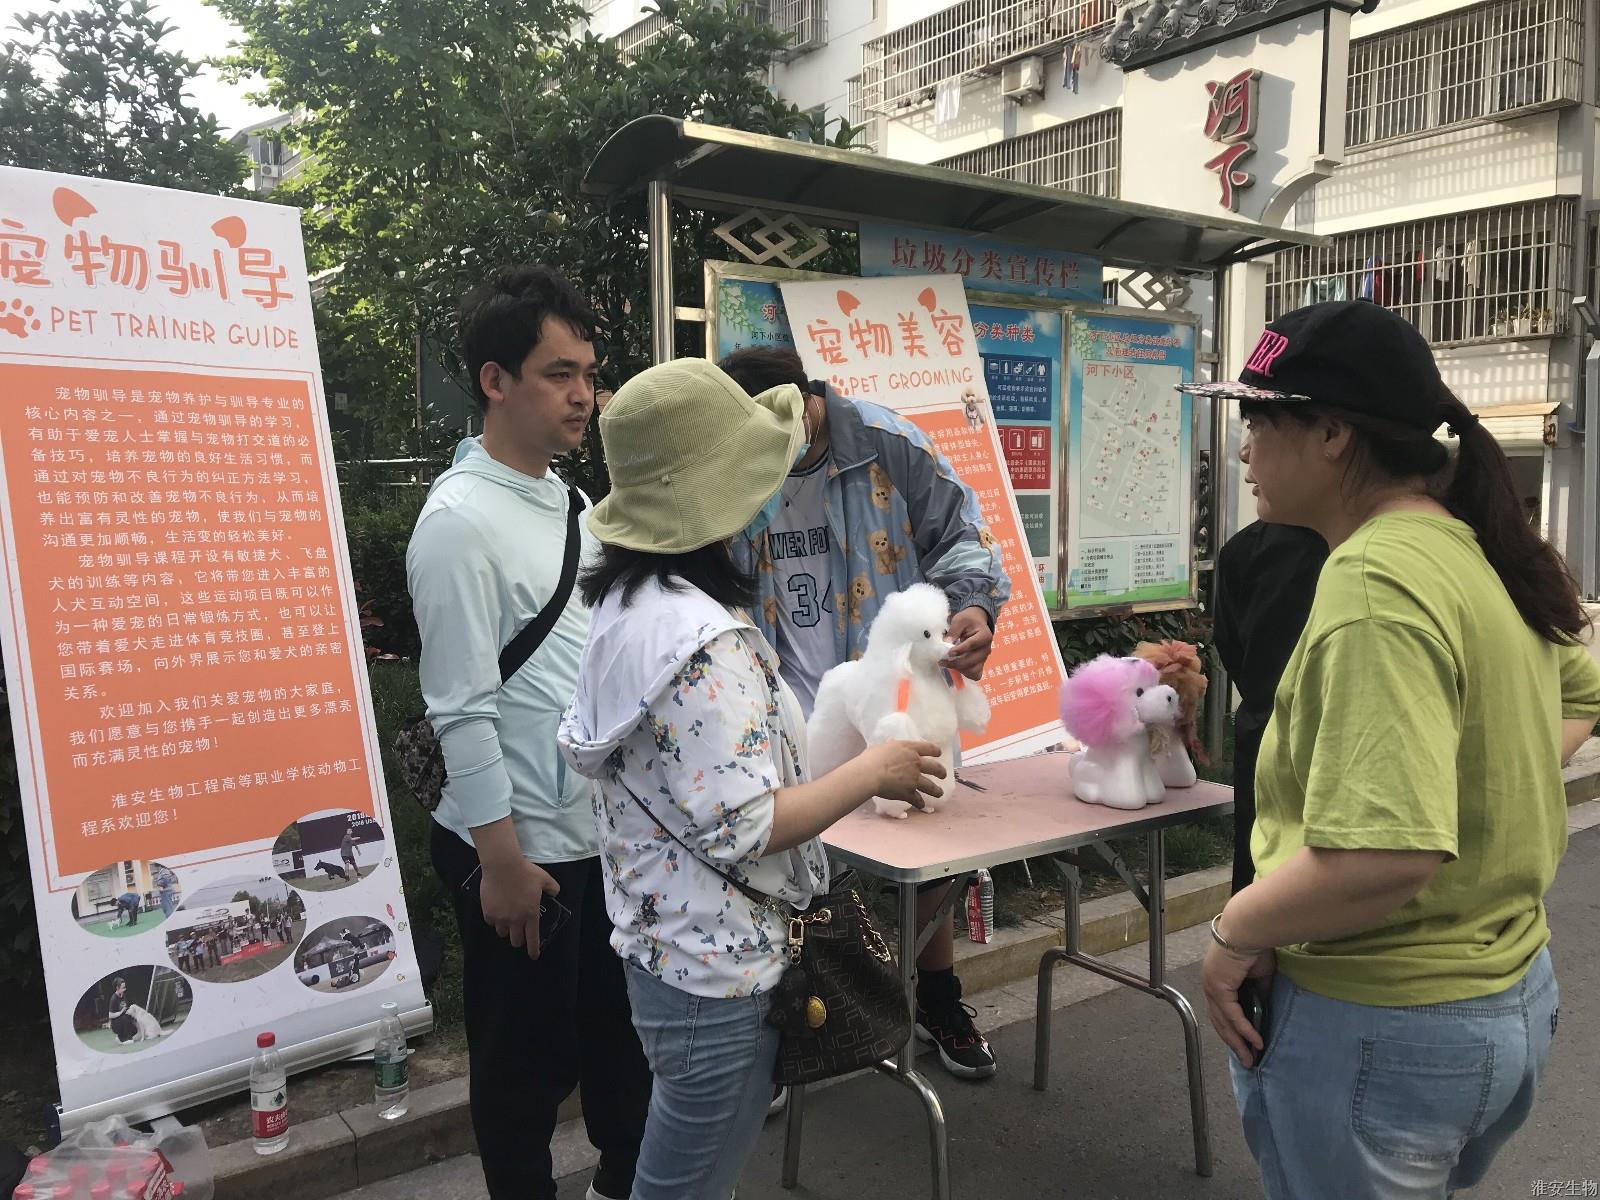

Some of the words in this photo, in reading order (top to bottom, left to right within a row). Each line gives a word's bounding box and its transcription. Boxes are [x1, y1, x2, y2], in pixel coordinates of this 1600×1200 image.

[1203, 67, 1258, 211] 河下
[0, 218, 295, 310] 宠物驯导
[891, 236, 1080, 289] 垃圾分类宣传栏
[50, 306, 98, 335] PET
[111, 312, 216, 345] TRAINER
[228, 324, 299, 349] GUIDE
[806, 309, 965, 365] 宠物美容
[974, 321, 1035, 343] 分类种类
[850, 375, 878, 395] PET
[888, 367, 975, 391] GROOMING
[1086, 364, 1136, 379] 河下小区
